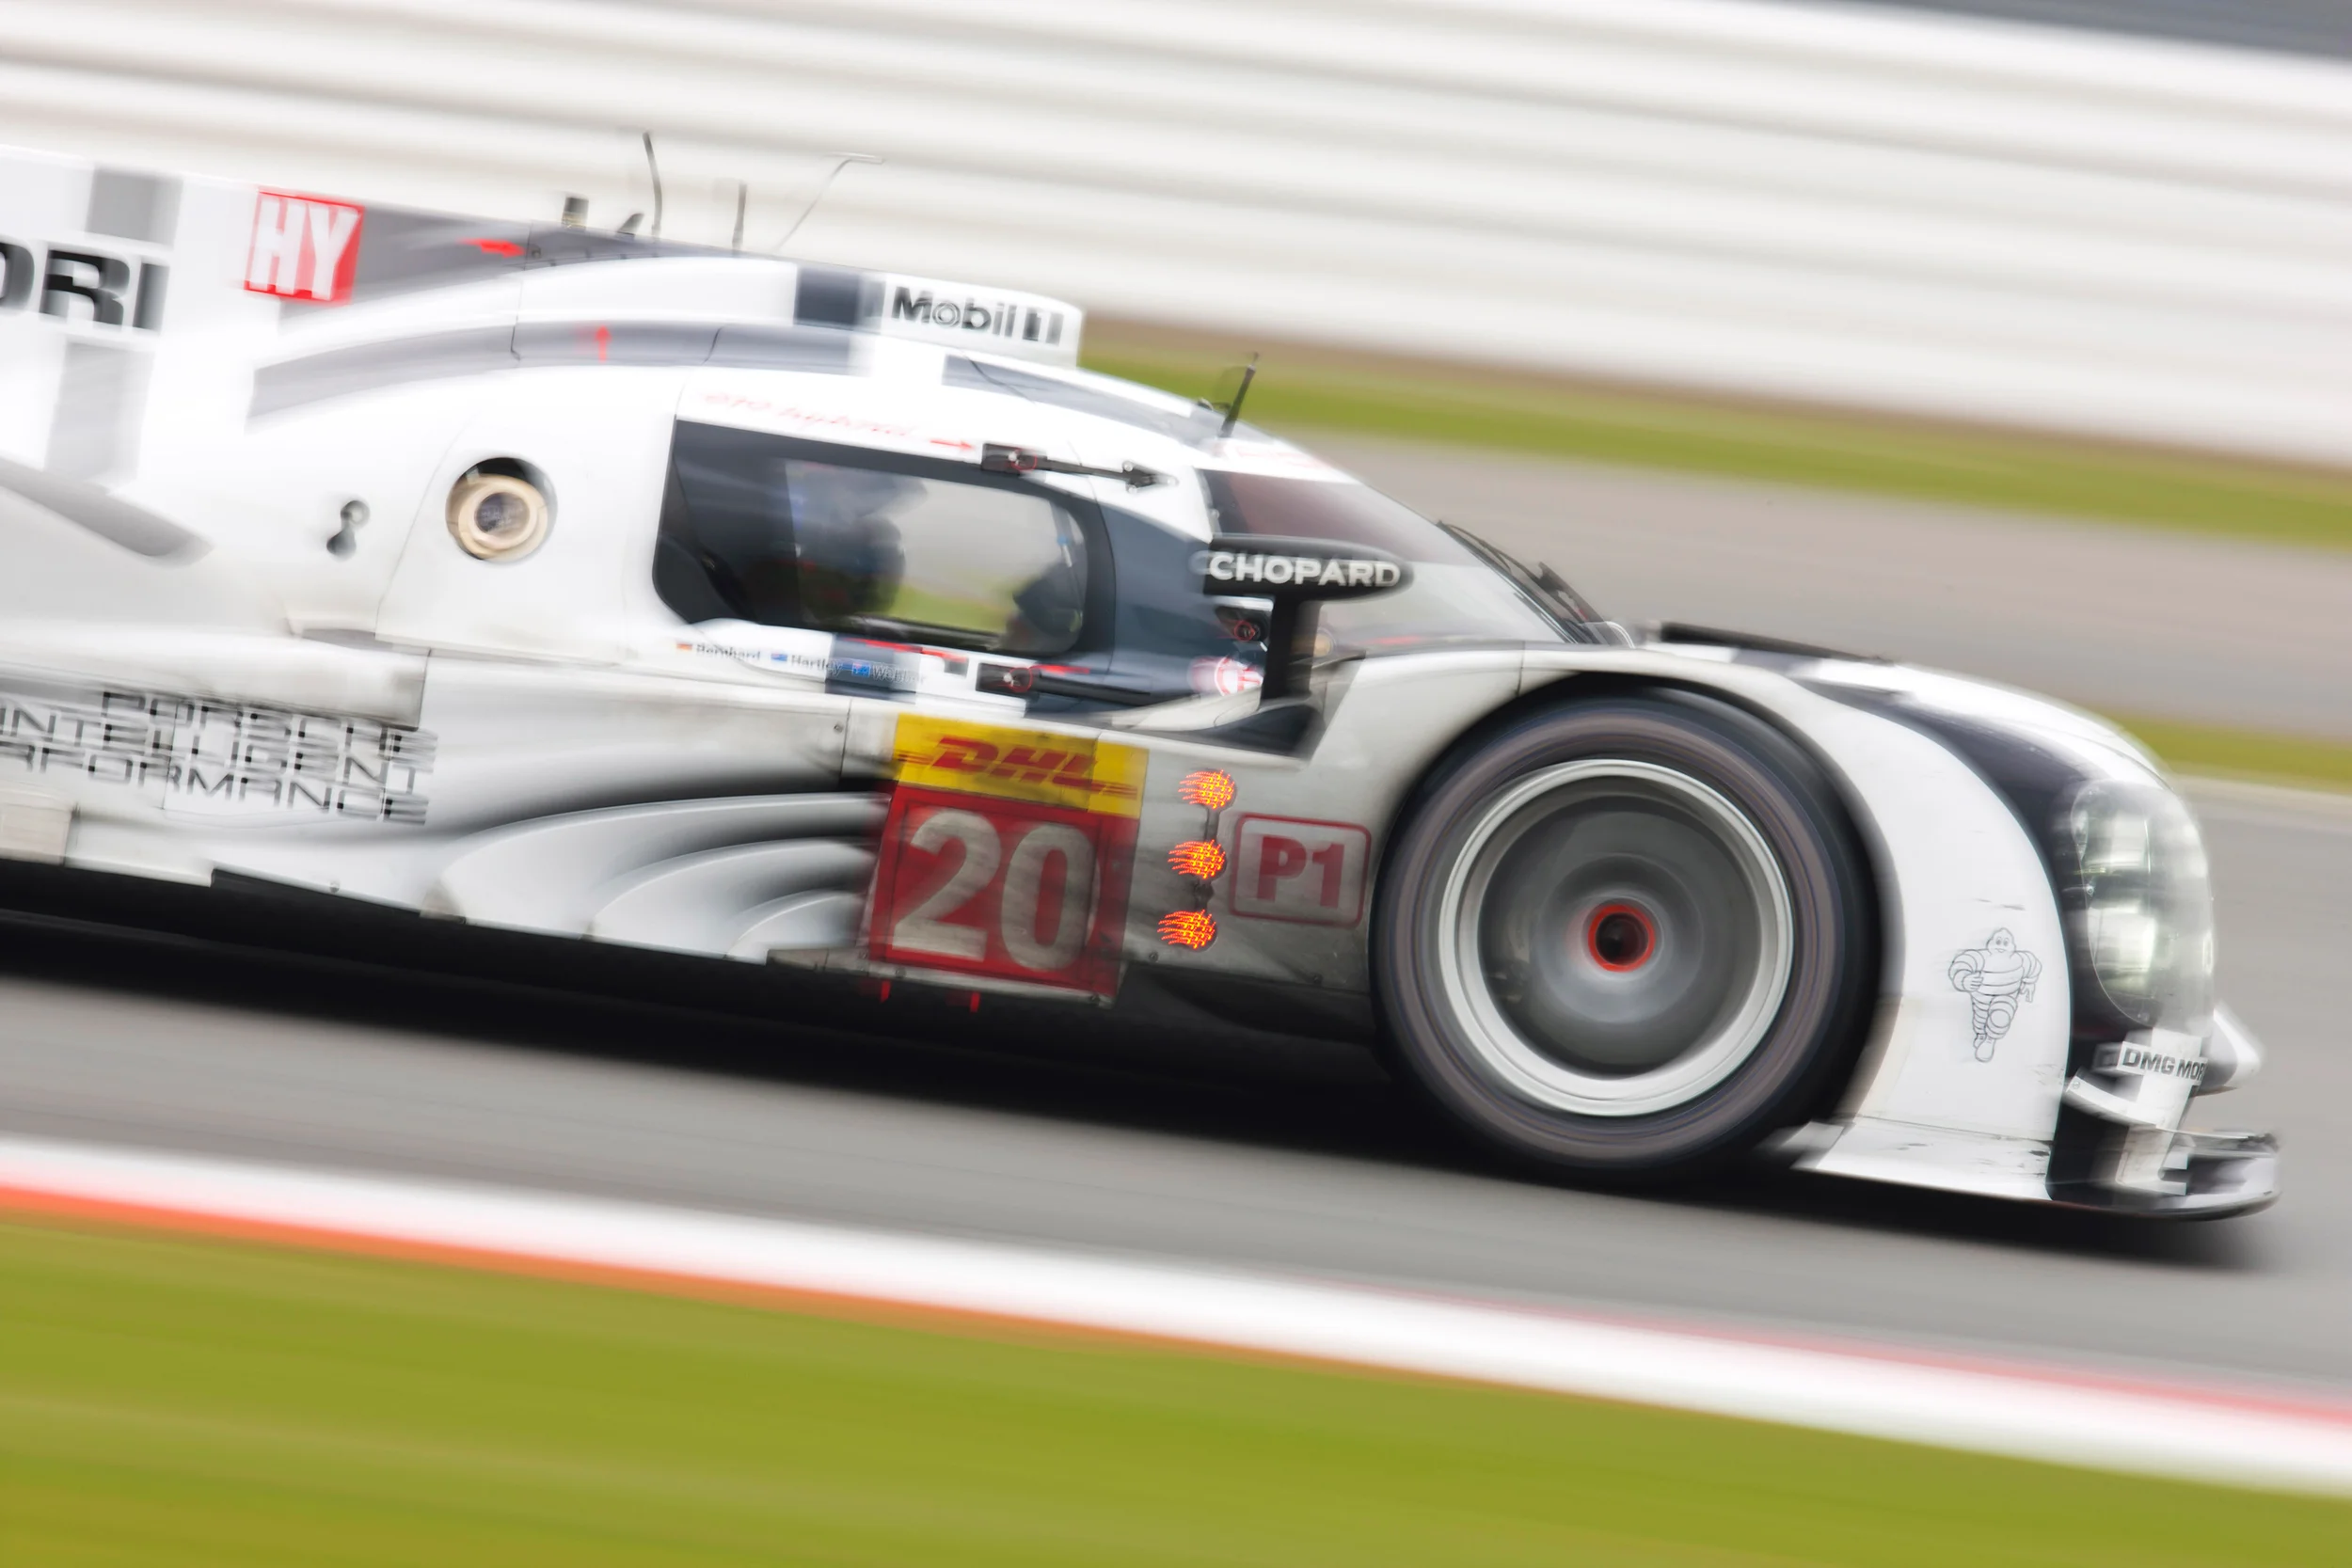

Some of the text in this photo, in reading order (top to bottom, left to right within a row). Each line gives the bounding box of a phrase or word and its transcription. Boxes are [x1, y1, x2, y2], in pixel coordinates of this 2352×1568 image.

[249, 195, 358, 301] HY
[891, 285, 1017, 338] Mobil
[1210, 552, 1401, 587] CHOPARD
[930, 736, 1106, 795] DHL
[892, 806, 1094, 971] 20
[1258, 835, 1344, 909] P1
[2122, 1048, 2175, 1075] DMG
